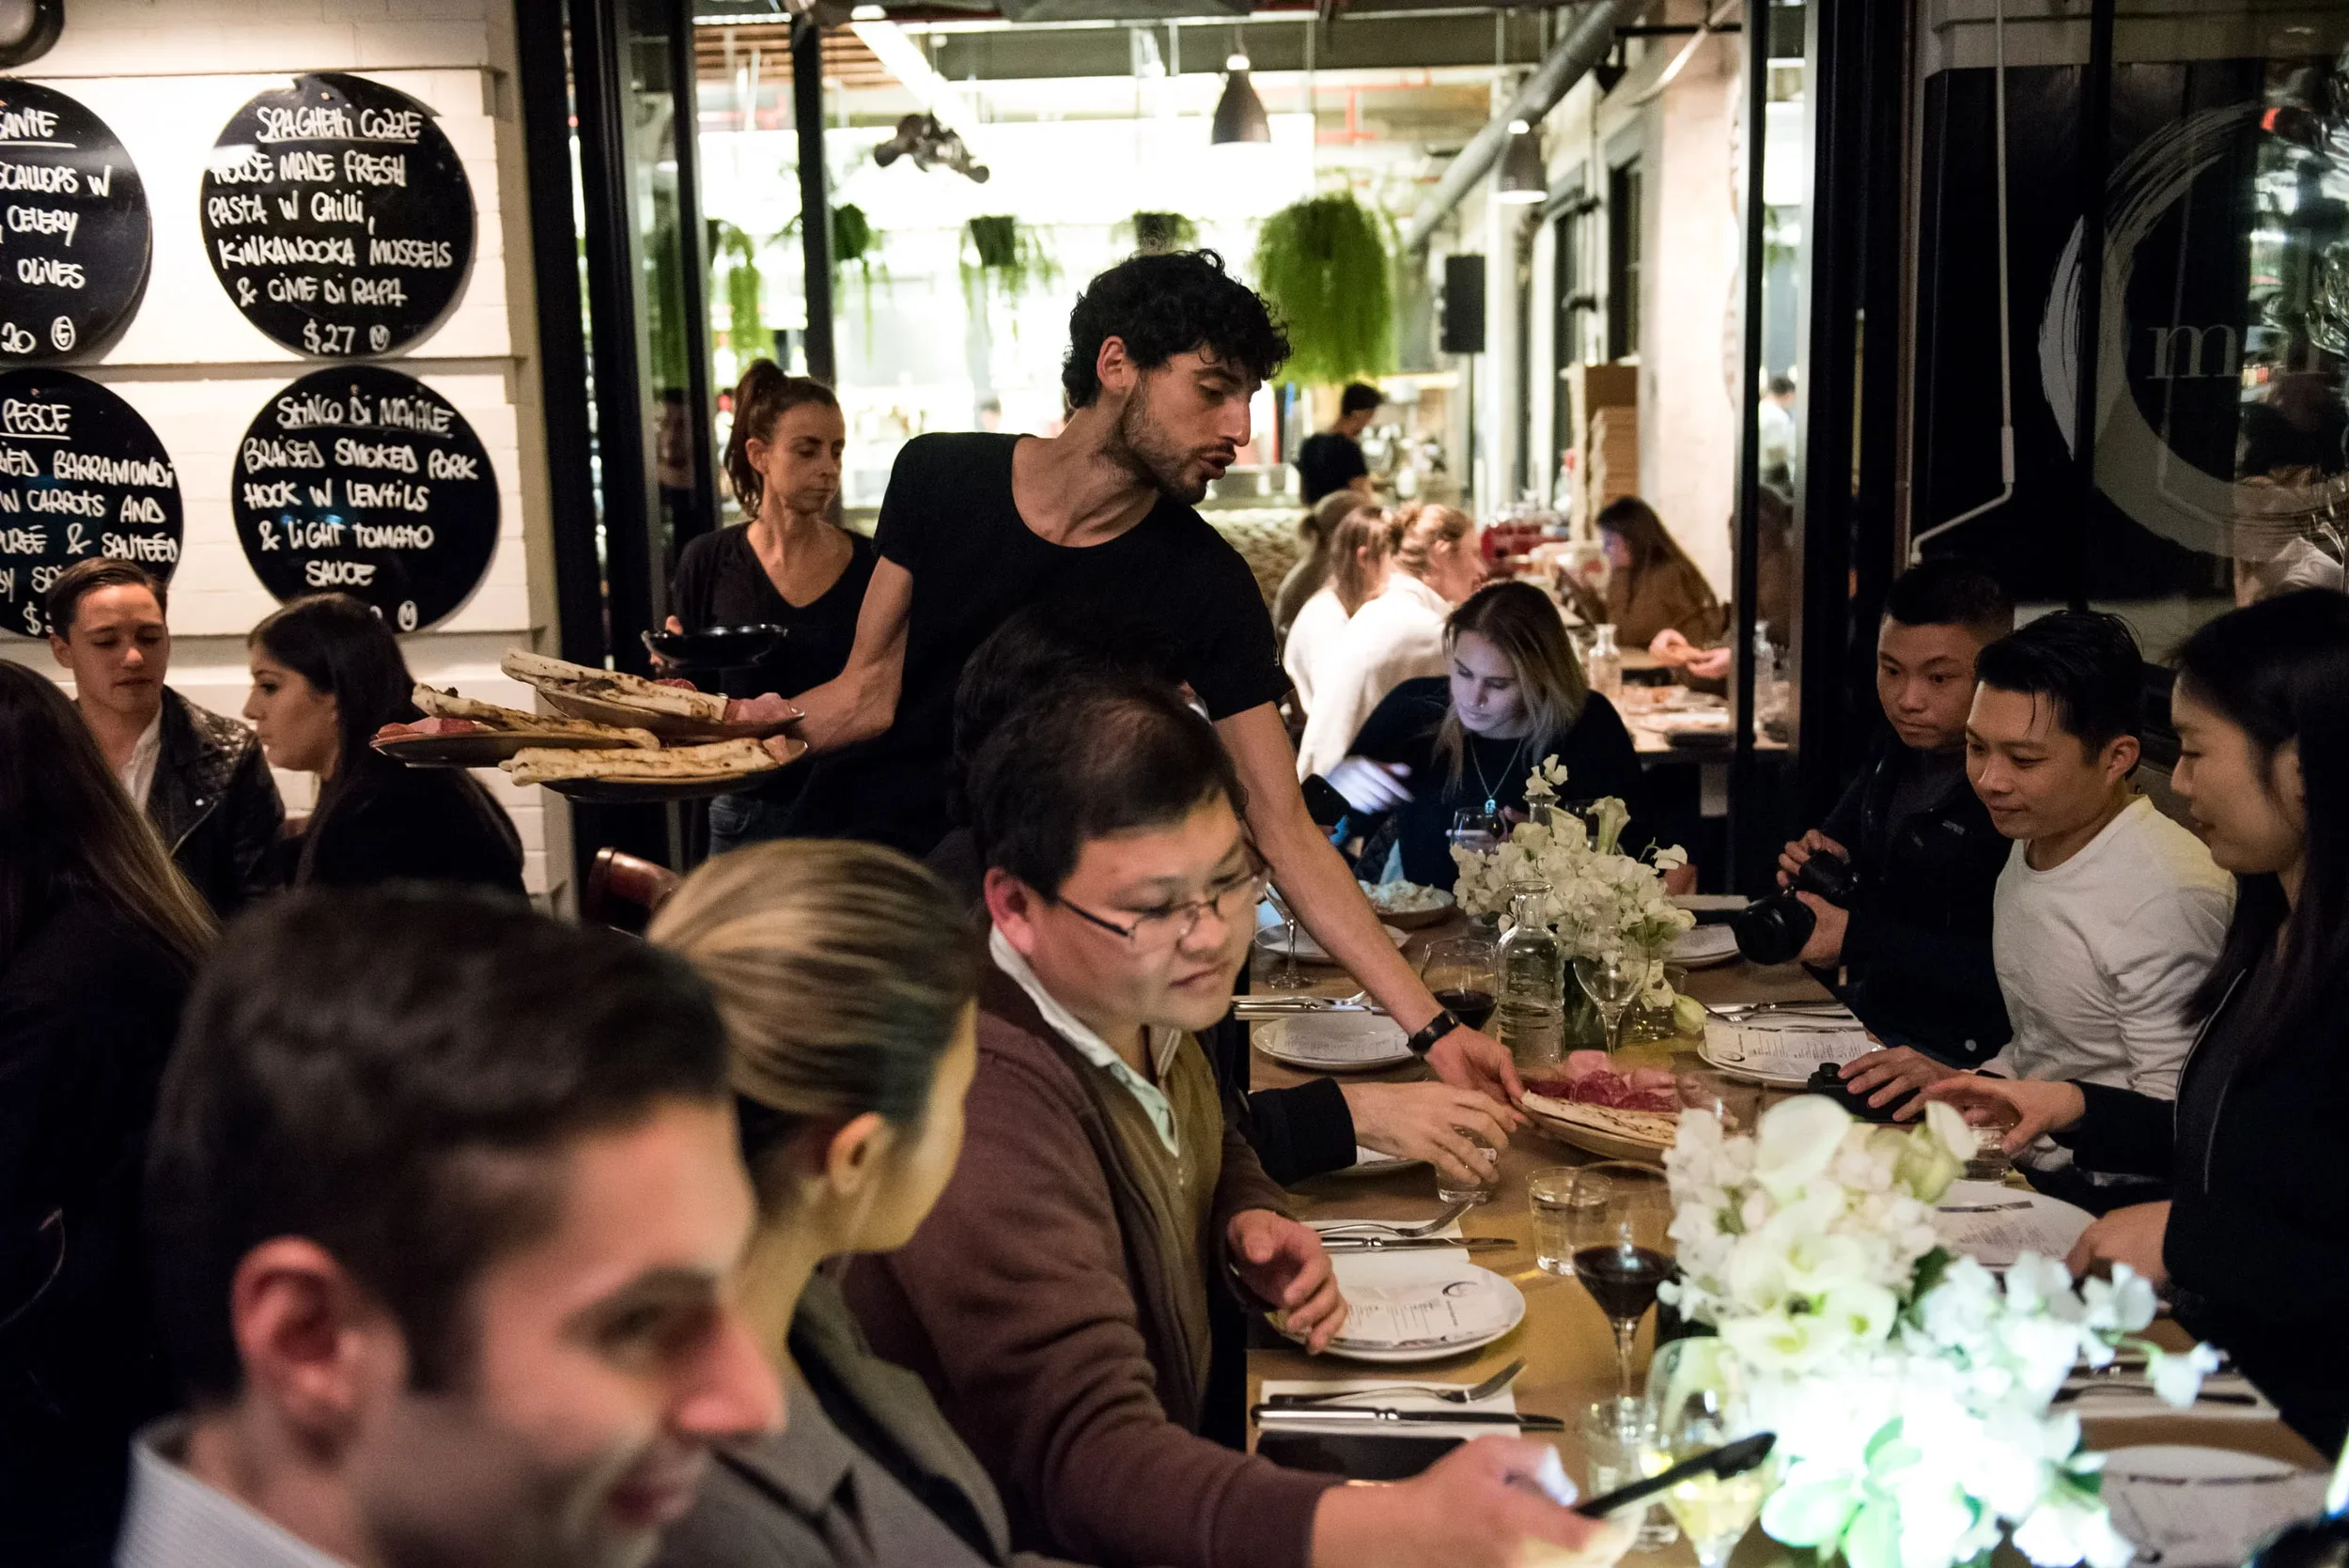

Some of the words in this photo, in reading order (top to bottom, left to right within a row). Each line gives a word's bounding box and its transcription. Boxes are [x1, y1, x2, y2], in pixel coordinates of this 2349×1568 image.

[280, 150, 335, 182] MADE
[344, 149, 407, 187] FRESH
[7, 205, 79, 246] CELERY
[369, 239, 453, 269] MUSSELS
[237, 277, 258, 307] &
[351, 277, 408, 307] RAPA
[303, 318, 356, 354] $27
[3, 398, 71, 433] PESCE
[334, 438, 419, 474] SMOKED
[428, 448, 478, 480] PORK
[119, 494, 166, 524] AND
[243, 480, 302, 510] HOCK
[67, 521, 92, 555] &
[258, 520, 281, 551] &
[305, 559, 377, 587] SAUCE
